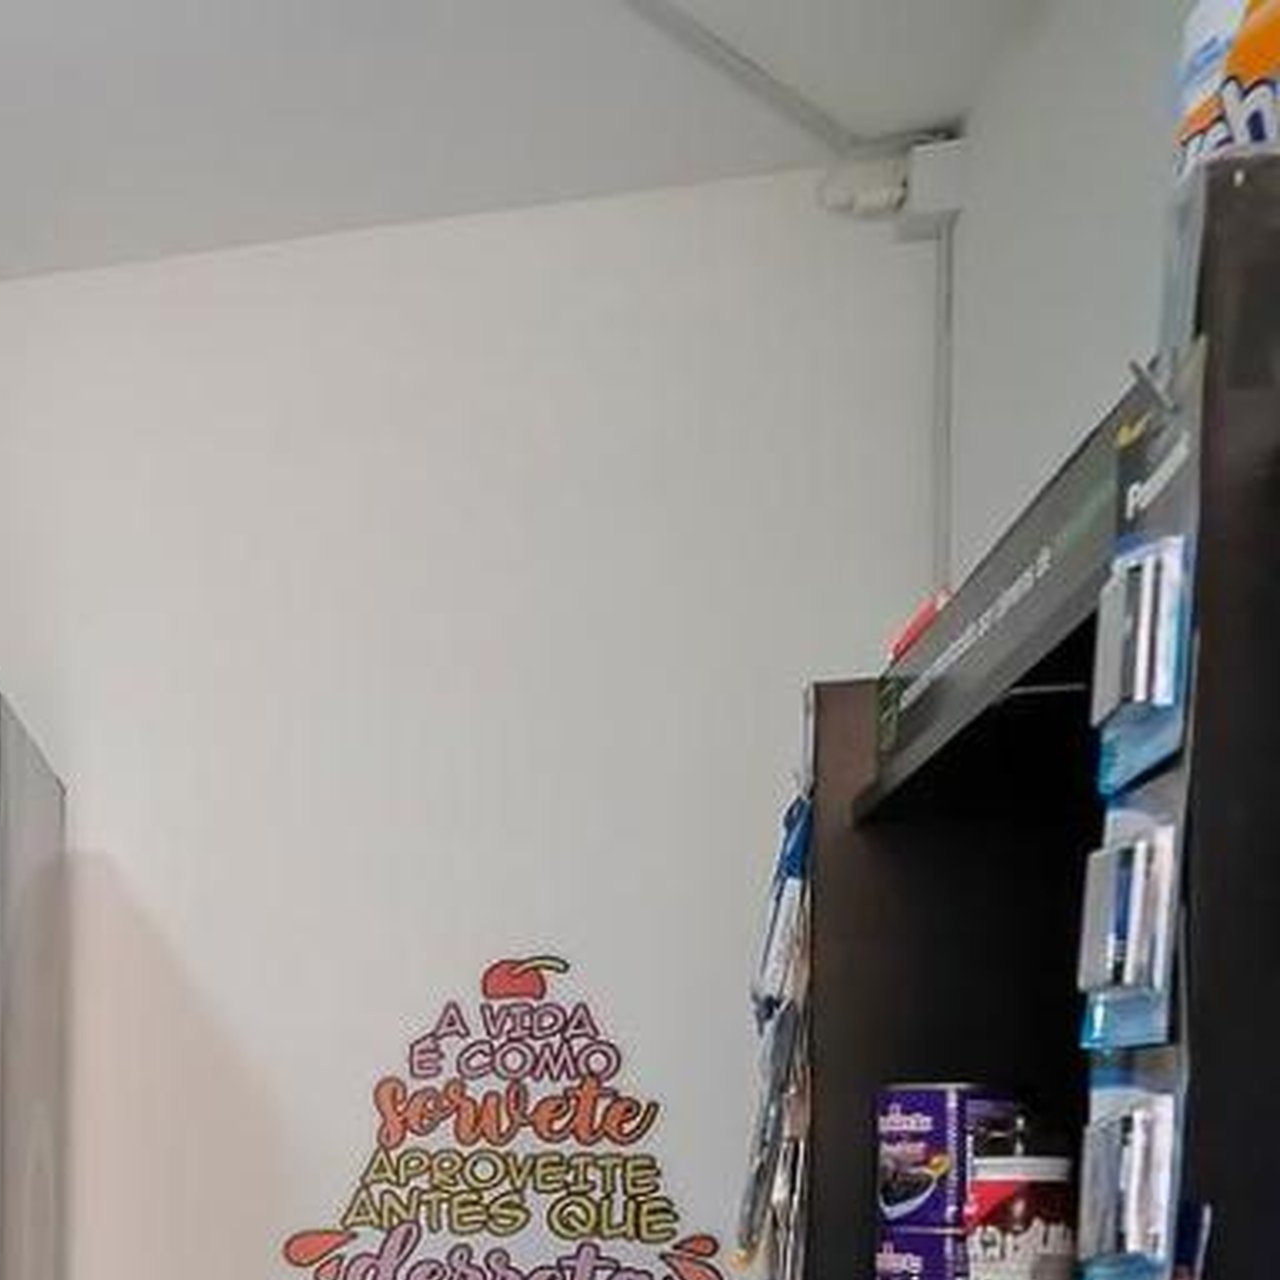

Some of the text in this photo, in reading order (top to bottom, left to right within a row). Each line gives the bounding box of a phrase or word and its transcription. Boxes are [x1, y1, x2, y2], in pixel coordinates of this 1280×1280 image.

[435, 1002, 600, 1040] A VIDA
[456, 1039, 623, 1082] COMO
[362, 1146, 664, 1196] APROVEITE
[340, 1187, 681, 1244] ANTES QUE
